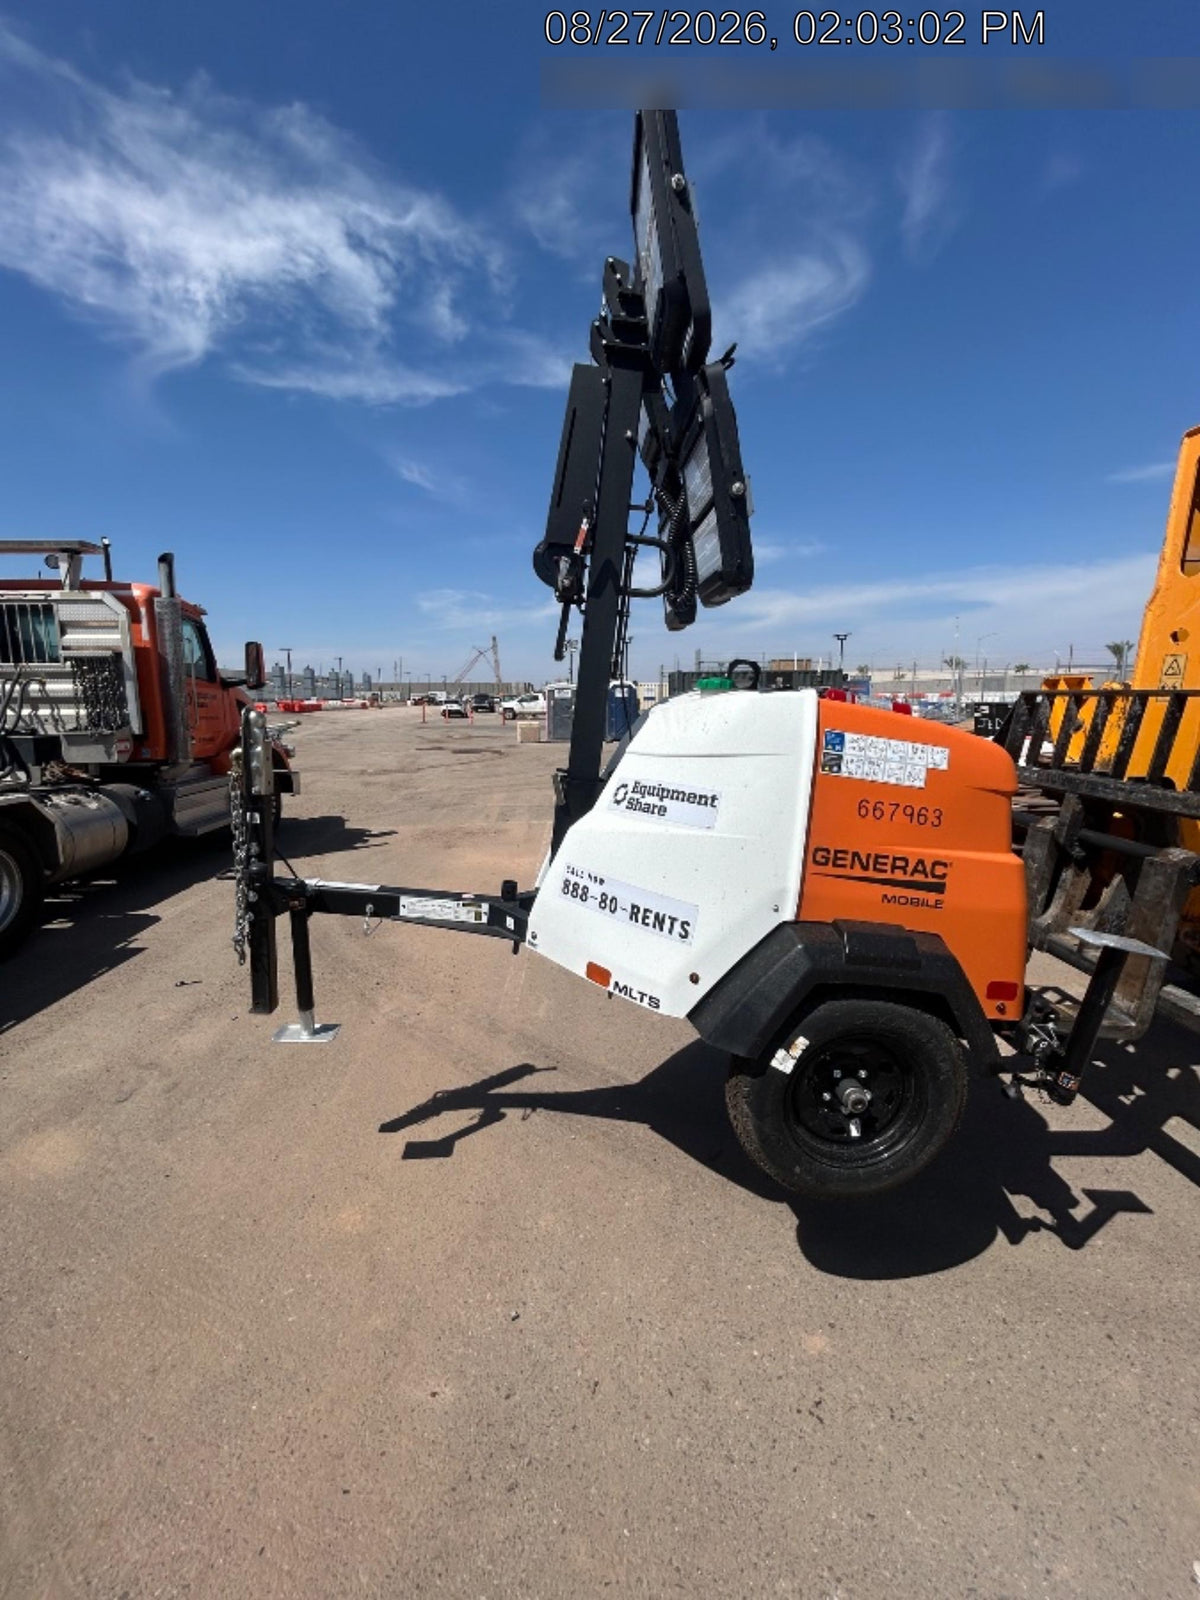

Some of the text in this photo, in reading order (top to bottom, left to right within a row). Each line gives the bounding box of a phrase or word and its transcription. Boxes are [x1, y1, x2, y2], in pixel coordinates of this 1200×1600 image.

[625, 797, 668, 817] Share
[631, 781, 719, 808] Equipment
[857, 799, 944, 828] 667963
[811, 847, 950, 880] GENERAC
[561, 878, 692, 940] 888-80-RENTS
[881, 893, 944, 910] MOBILE
[613, 980, 661, 1010] MLTS
